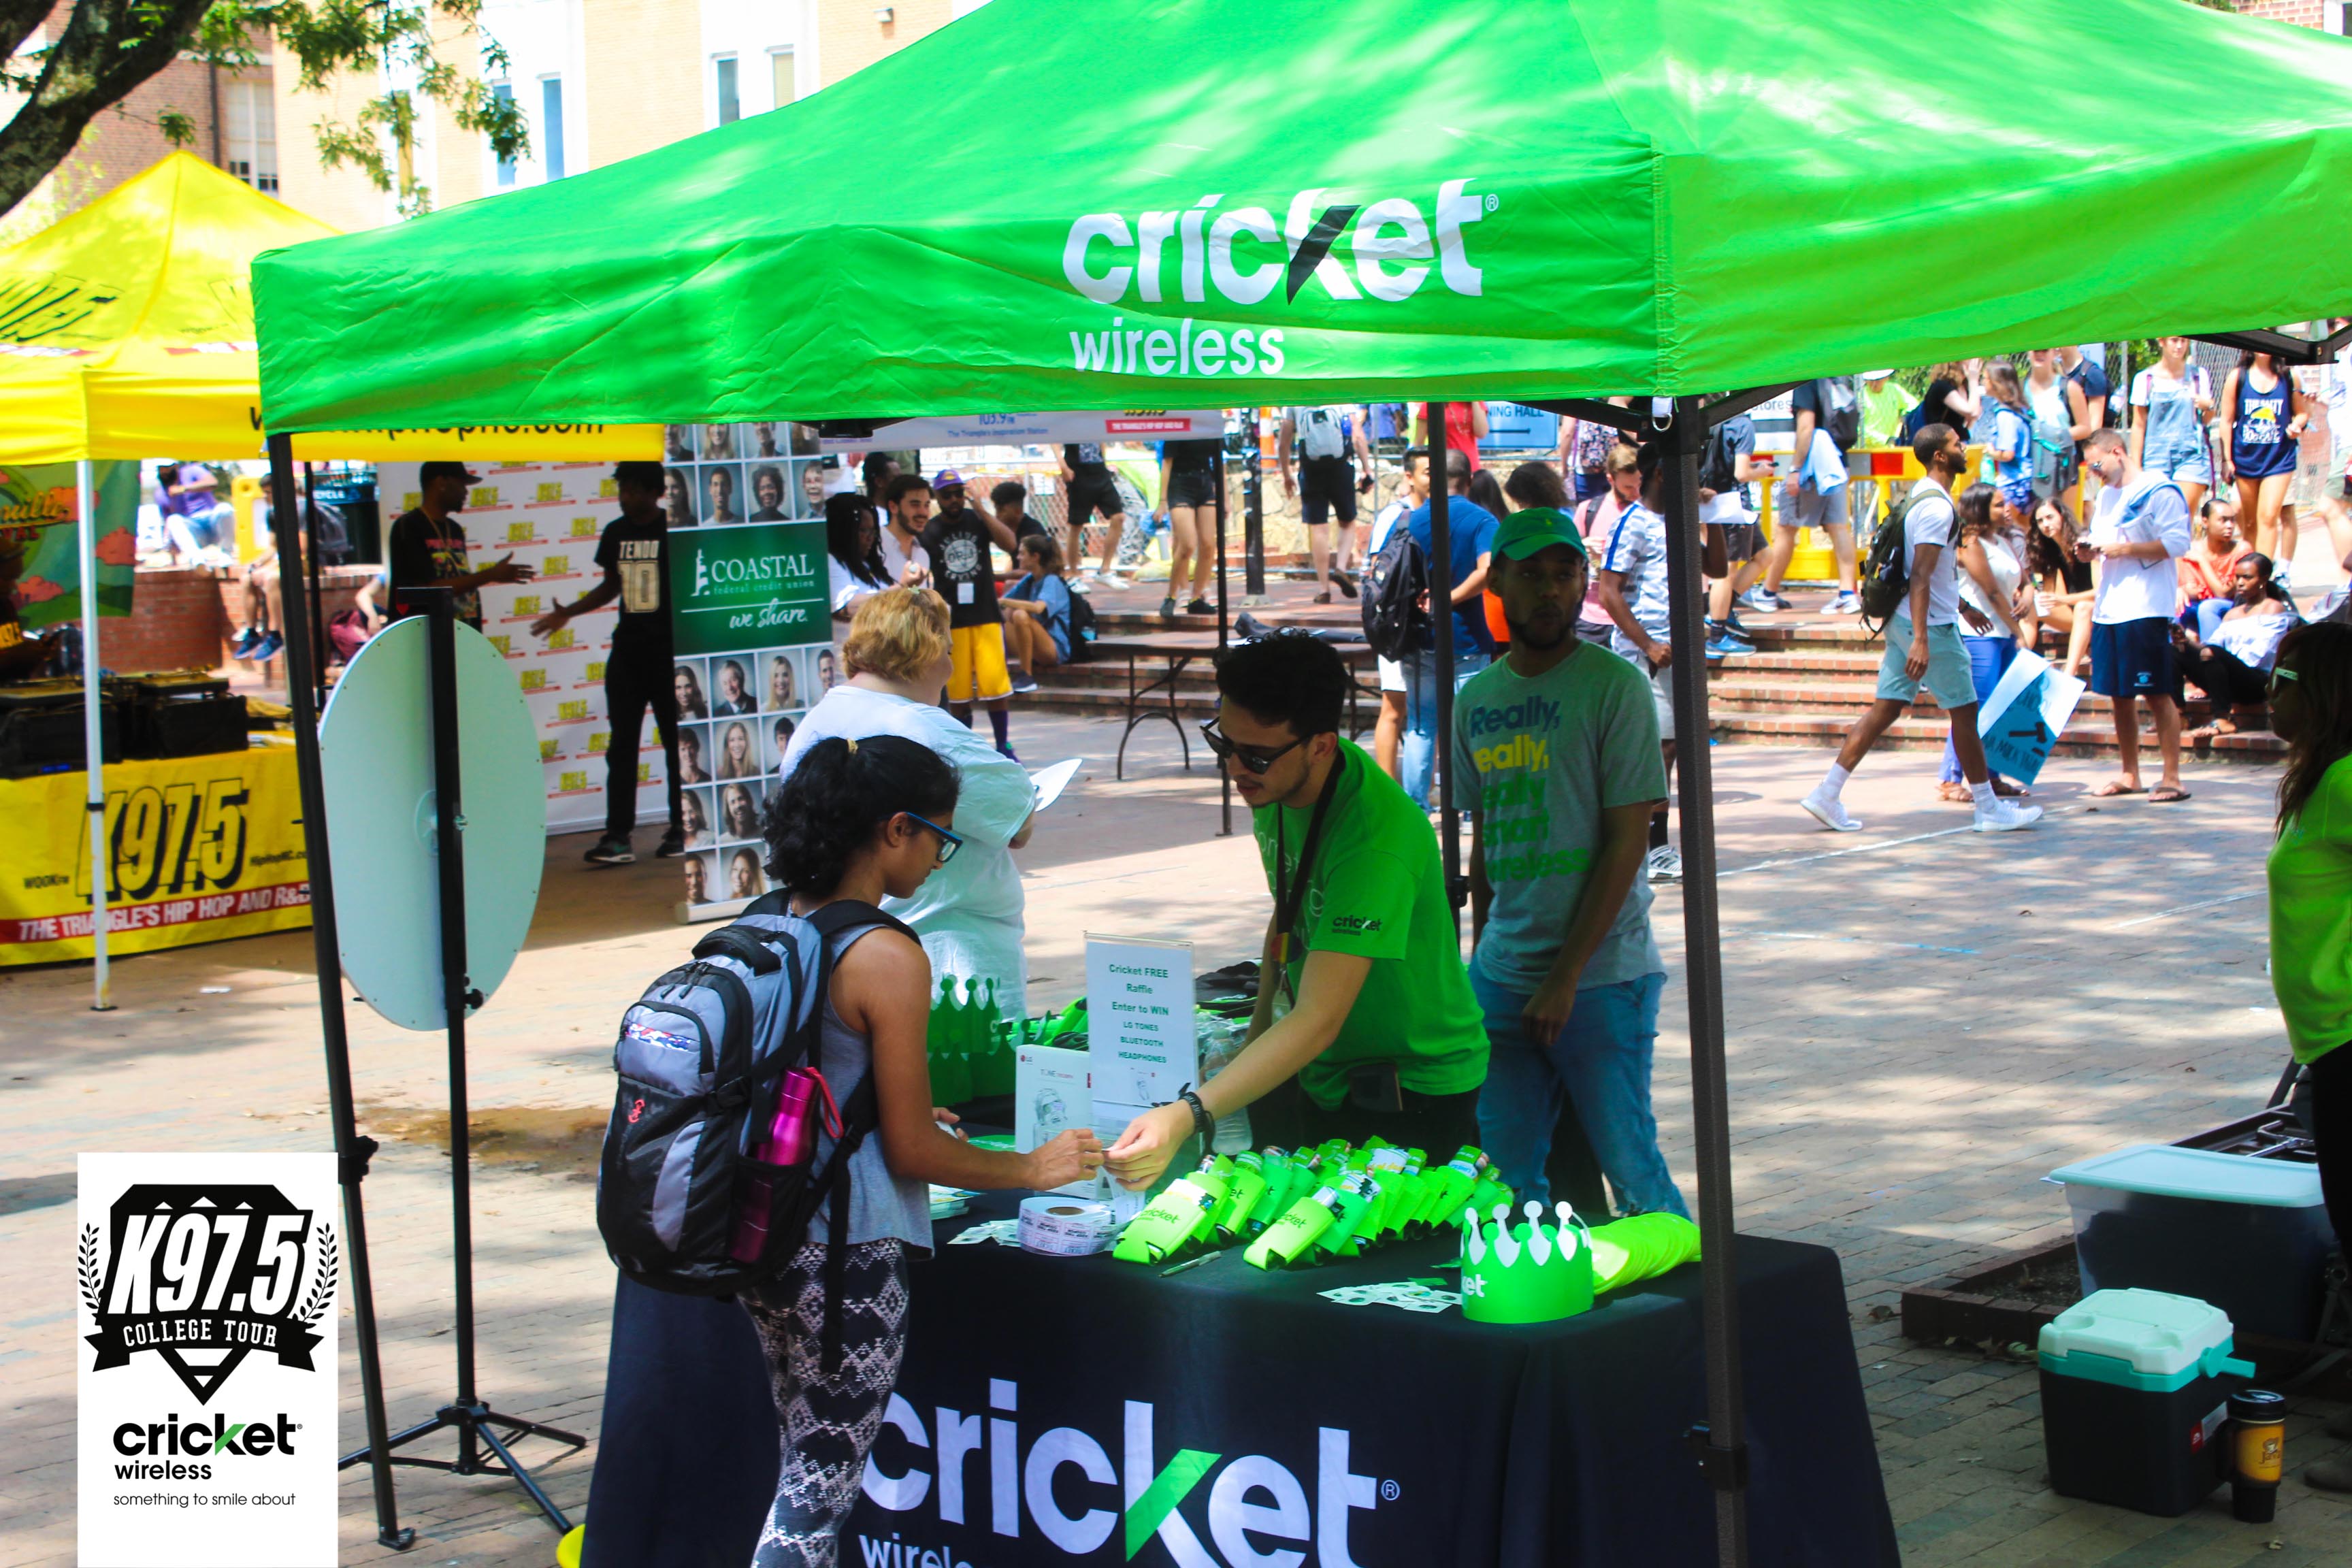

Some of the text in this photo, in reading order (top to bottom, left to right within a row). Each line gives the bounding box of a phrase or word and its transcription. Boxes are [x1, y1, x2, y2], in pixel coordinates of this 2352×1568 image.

[1062, 178, 1482, 305] cricket
[1070, 317, 1284, 375] wireless
[711, 554, 815, 583] COASTAL
[617, 559, 661, 613] 10
[715, 579, 815, 595] federal credit union
[729, 614, 753, 629] we
[1470, 695, 1561, 738] Really,
[1481, 772, 1546, 811] eally
[76, 778, 250, 905] K97.5
[19, 920, 58, 942] THE
[60, 904, 161, 936] TRIAGLE'S
[163, 898, 195, 924] HIP
[198, 892, 235, 919] HOP
[237, 887, 272, 913] AND
[1333, 914, 1382, 932] cricket
[1109, 964, 1169, 978] Cricket FREE
[1126, 983, 1153, 994] Raffle
[1112, 1001, 1169, 1015] Enter to WIN
[1134, 1022, 1159, 1031] TONES
[1120, 1036, 1164, 1047] BLUETOOTH
[1118, 1051, 1167, 1063] HEADPHONES
[860, 1378, 1377, 1568] cricket
[858, 1532, 974, 1568] wirel
